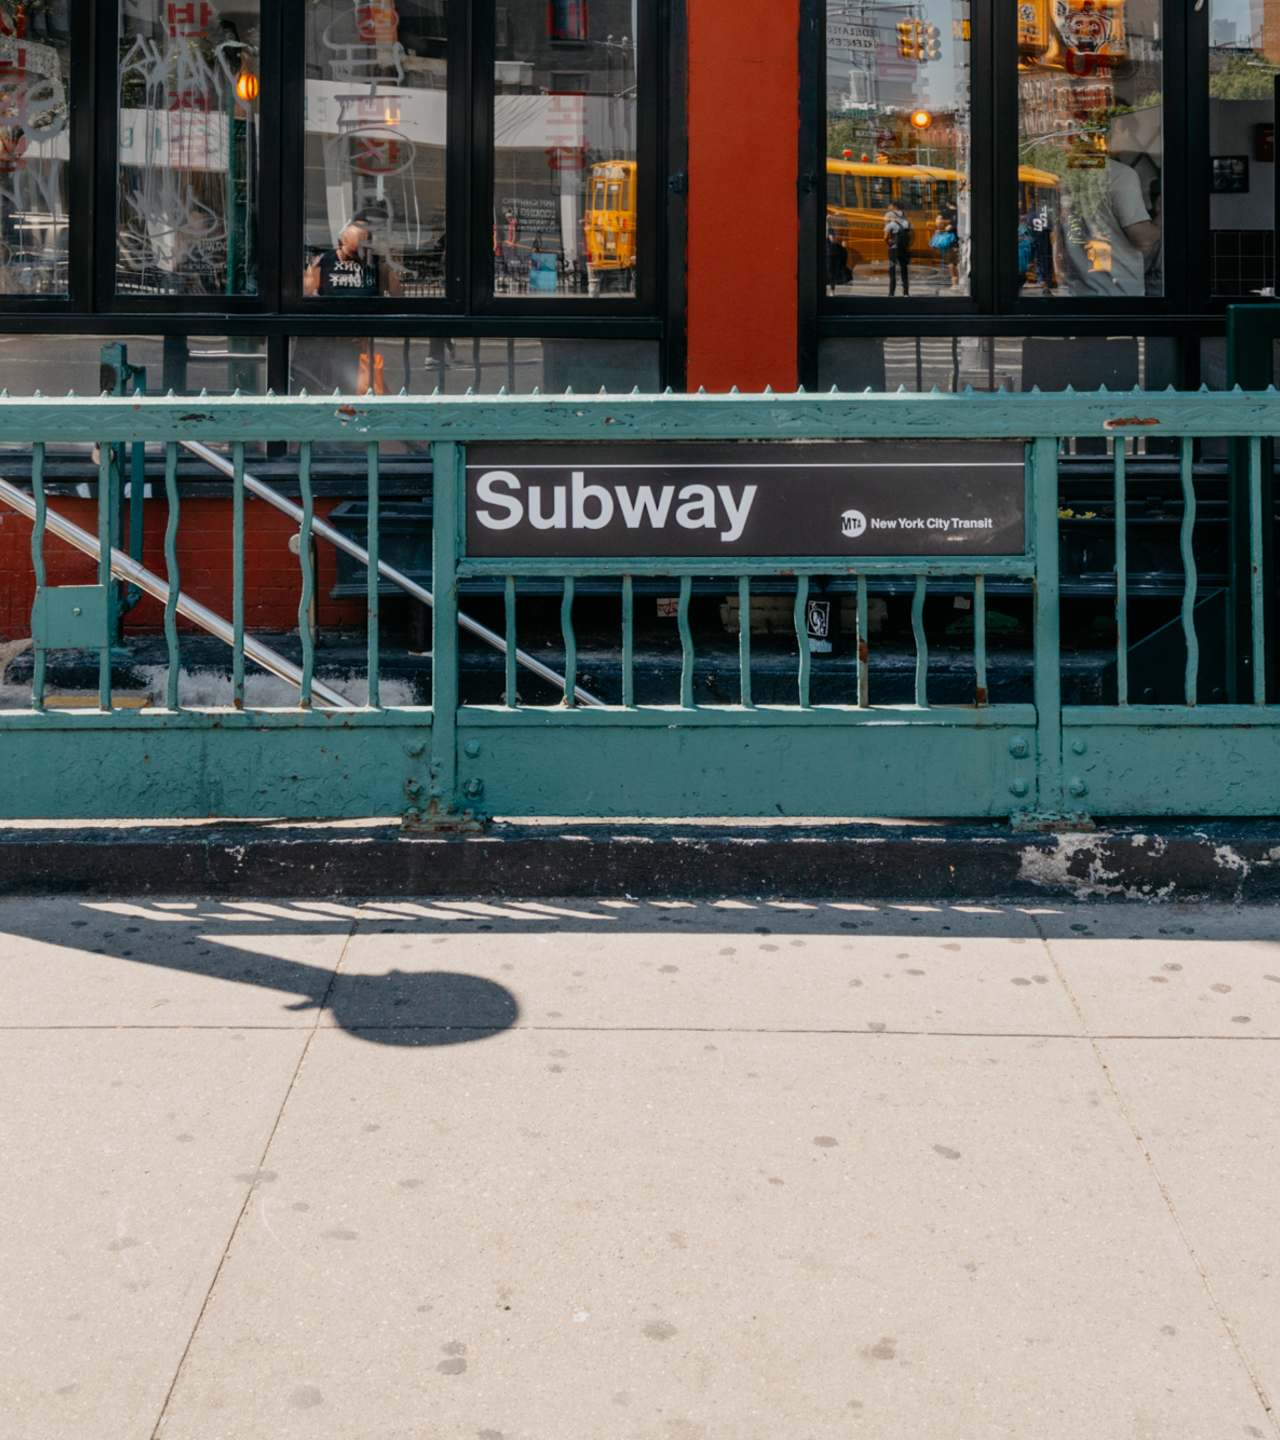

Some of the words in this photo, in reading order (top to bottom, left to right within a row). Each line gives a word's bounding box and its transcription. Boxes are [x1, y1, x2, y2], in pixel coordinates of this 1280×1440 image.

[476, 471, 757, 542] Subway
[871, 517, 897, 529] New
[898, 517, 925, 529] York
[926, 517, 951, 532] City
[951, 517, 993, 529] Transit
